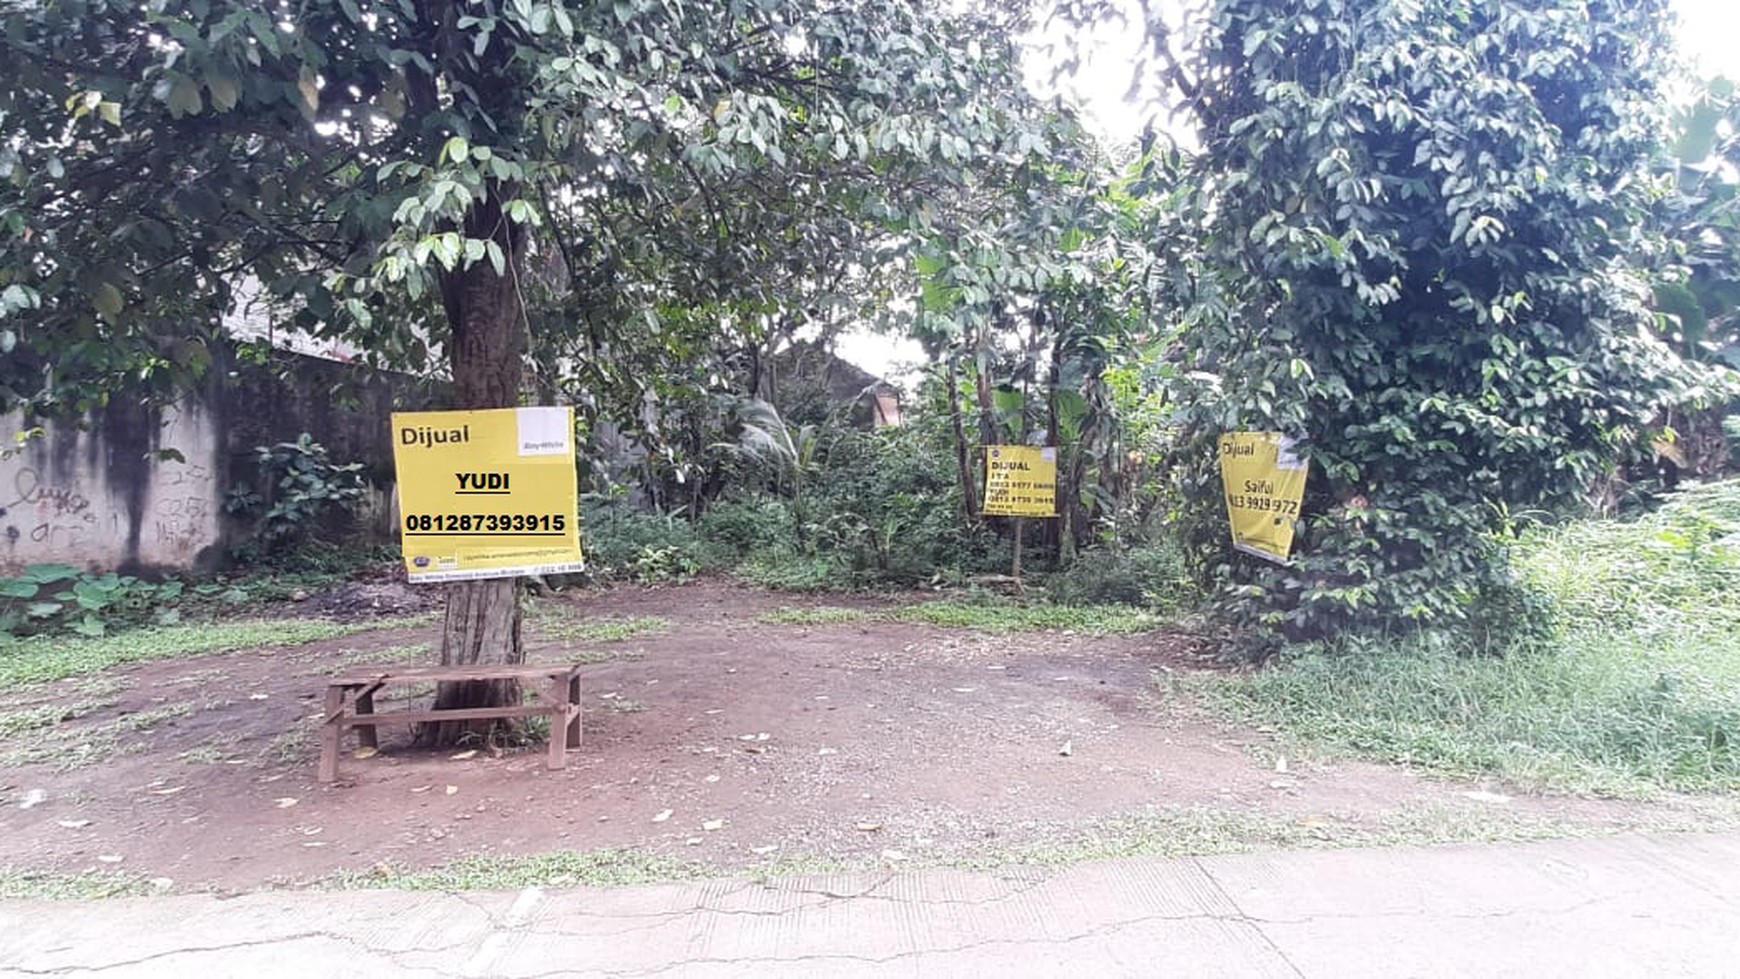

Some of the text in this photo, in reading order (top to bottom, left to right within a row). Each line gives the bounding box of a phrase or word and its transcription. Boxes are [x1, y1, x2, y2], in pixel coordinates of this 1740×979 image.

[401, 425, 470, 448] Dijual
[1222, 442, 1255, 458] Dijual
[991, 462, 1031, 471] DIJUAL
[1244, 480, 1274, 494] Saiful
